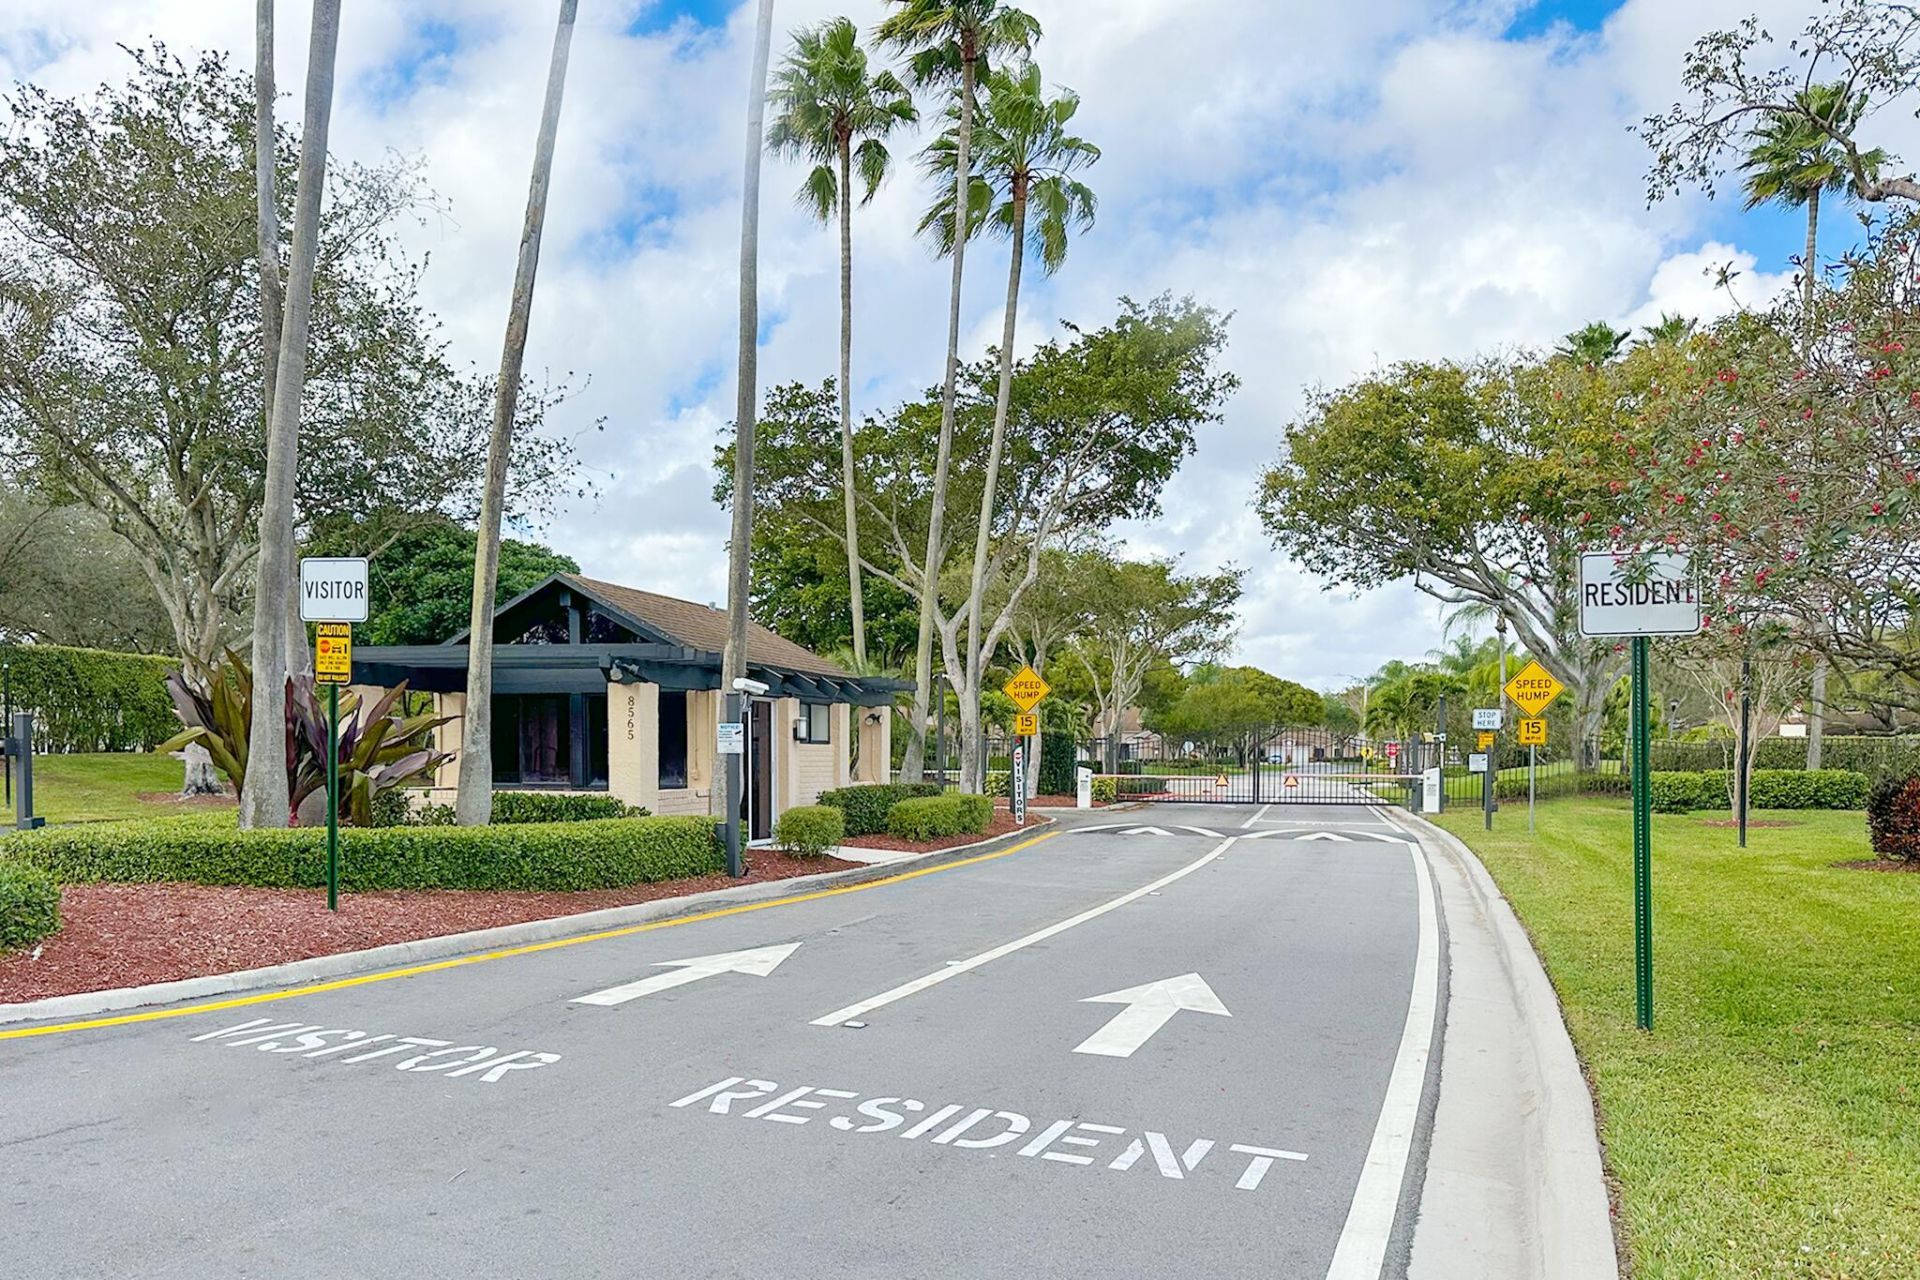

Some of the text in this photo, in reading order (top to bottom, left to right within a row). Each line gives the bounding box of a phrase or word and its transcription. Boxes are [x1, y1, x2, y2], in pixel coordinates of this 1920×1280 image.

[305, 581, 364, 599] VISITOR
[318, 624, 349, 636] CAUTION
[1013, 680, 1041, 690] SPEED
[1515, 679, 1552, 689] SPEED
[1013, 691, 1040, 700] HUMP
[1516, 691, 1550, 701] HUMP
[626, 695, 635, 741] 8565
[1477, 711, 1497, 719] STOP
[1020, 716, 1033, 727] 15
[1477, 719, 1497, 727] HERE
[1525, 721, 1541, 735] 15
[1015, 761, 1024, 822] VISITORS
[190, 1018, 562, 1083] VISITOR
[668, 1075, 1309, 1191] RESIDENT
